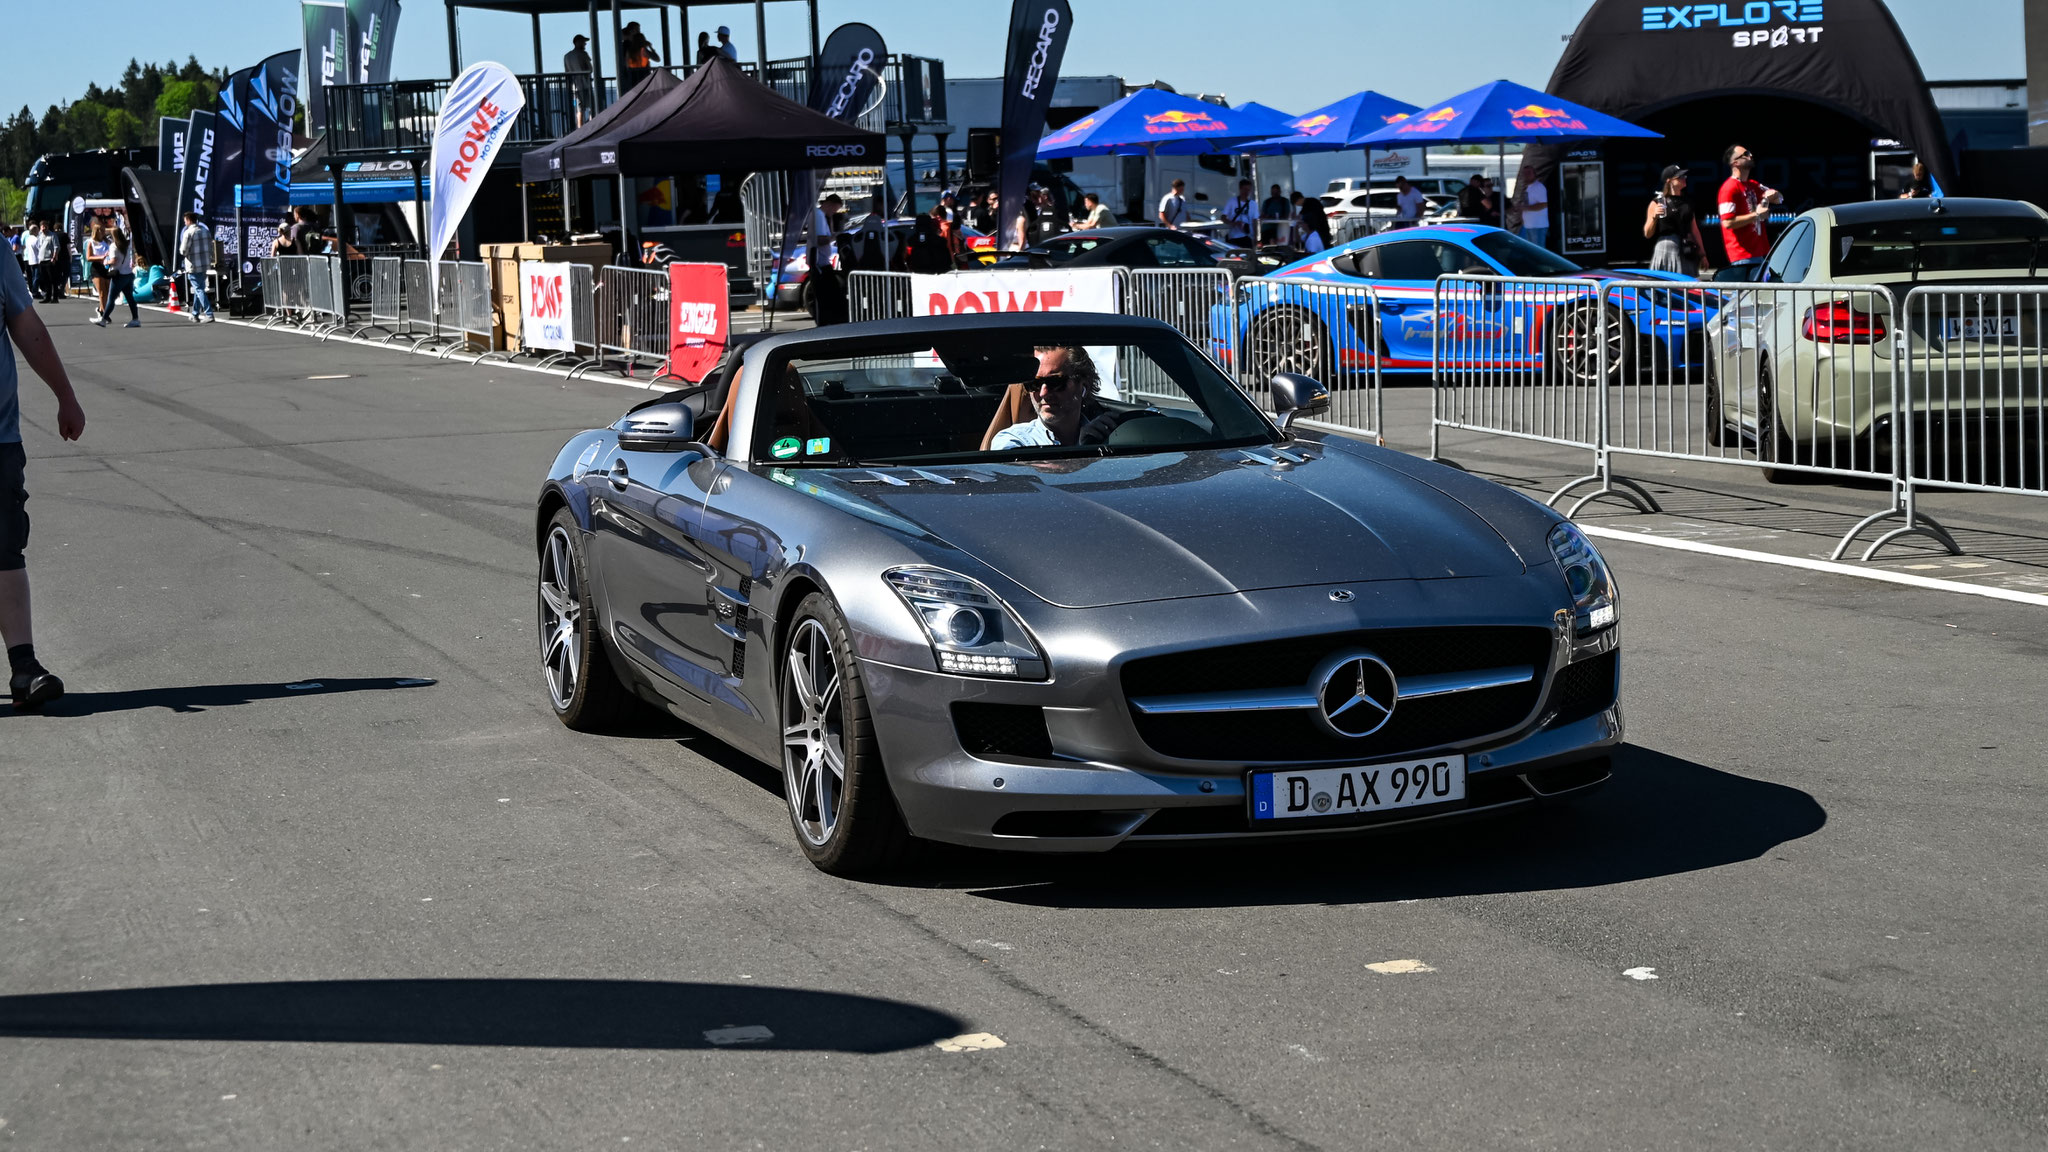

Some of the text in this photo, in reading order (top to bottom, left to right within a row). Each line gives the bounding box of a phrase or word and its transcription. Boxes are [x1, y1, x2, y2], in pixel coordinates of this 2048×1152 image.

[1643, 0, 1823, 29] EXPLORE
[1022, 8, 1059, 100] RECARO
[449, 96, 500, 183] ROWE
[1144, 121, 1228, 134] Red Bull
[806, 145, 865, 157] RECARO
[194, 128, 215, 216] RACING
[679, 302, 718, 336] ENGEL
[781, 439, 790, 448] 4
[1287, 761, 1450, 812] D AX 990
[1259, 801, 1268, 812] D
